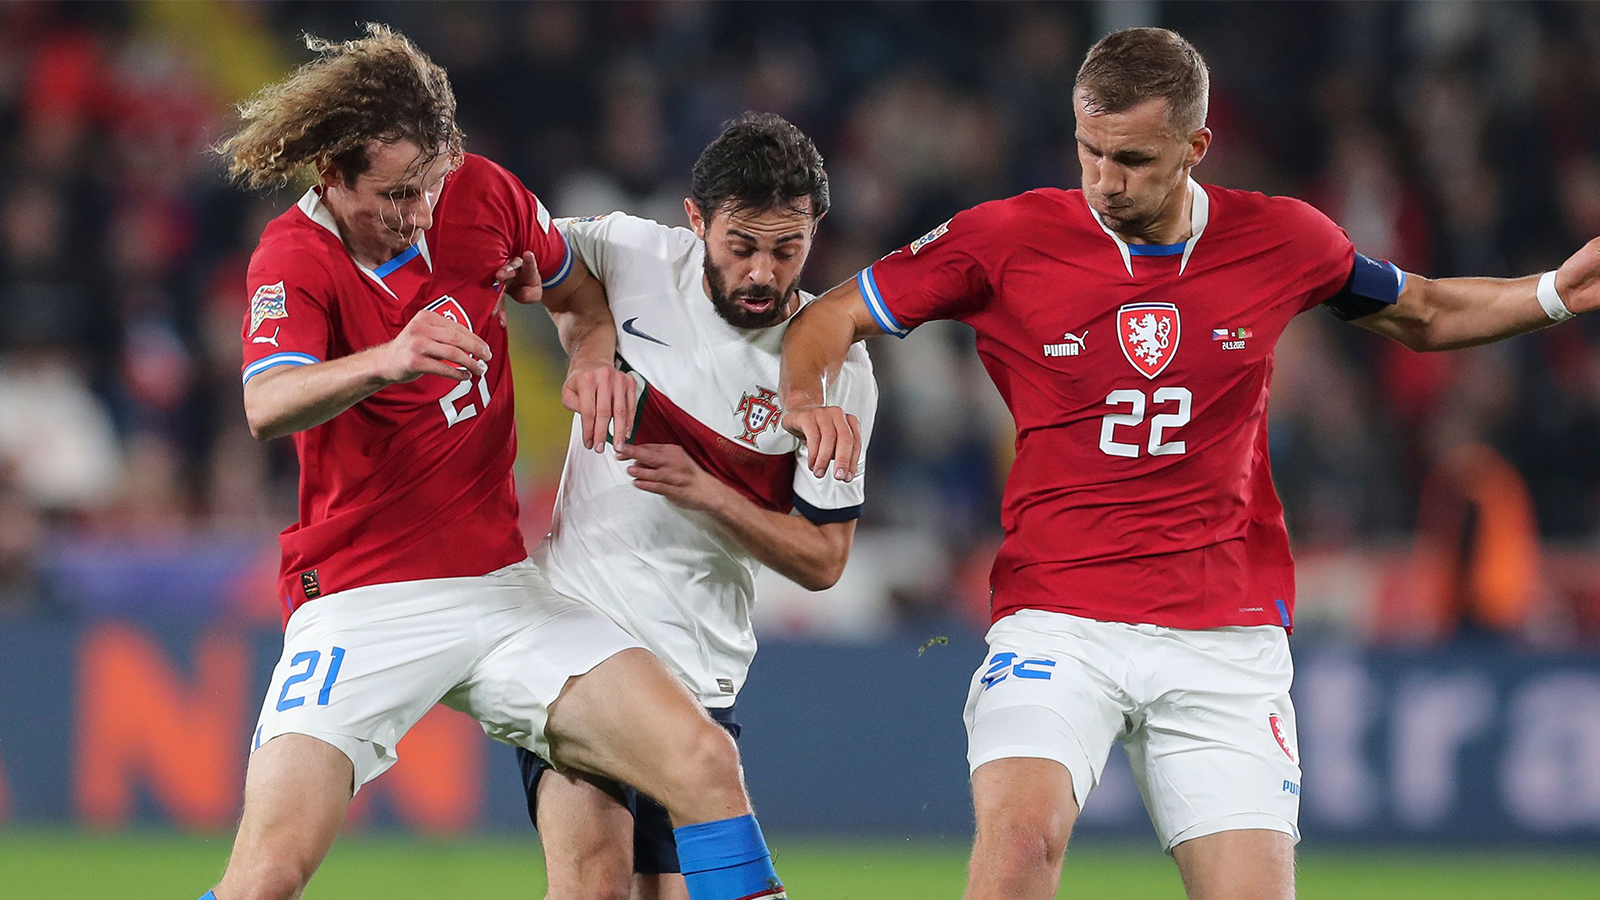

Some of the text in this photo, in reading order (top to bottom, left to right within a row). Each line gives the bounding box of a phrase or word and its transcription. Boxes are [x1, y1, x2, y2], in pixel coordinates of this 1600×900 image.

[1043, 343, 1079, 357] PUMA
[1099, 387, 1193, 458] 22
[276, 646, 346, 712] 21
